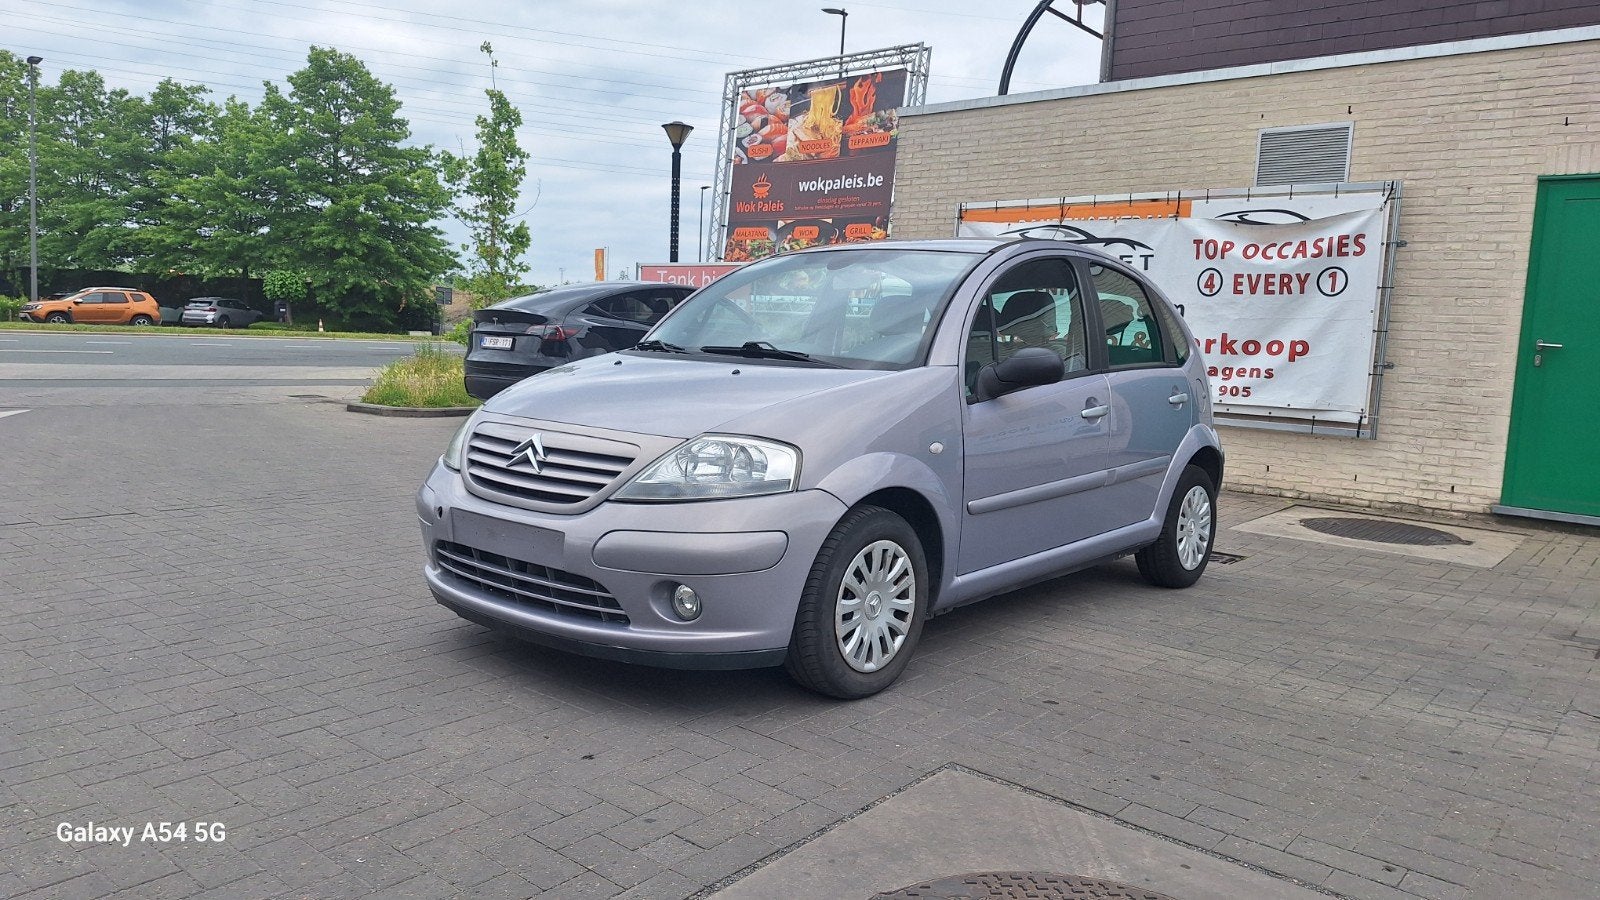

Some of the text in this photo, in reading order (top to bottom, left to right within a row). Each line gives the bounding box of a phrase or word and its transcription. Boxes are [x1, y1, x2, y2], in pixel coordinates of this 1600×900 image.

[850, 135, 889, 146] TEPPANYAKI
[751, 147, 768, 155] SUSHI
[801, 142, 831, 152] NOODLES
[798, 172, 884, 195] wokpaleis.be
[736, 200, 756, 213] Wok
[757, 199, 784, 212] Paleis
[736, 230, 767, 238] MALATANG
[849, 227, 867, 235] GRILL
[1193, 233, 1366, 260] TOP OCCASIES
[657, 270, 696, 287] Tank
[1203, 271, 1338, 295] 4 EVERY 1
[1219, 385, 1252, 397] 905
